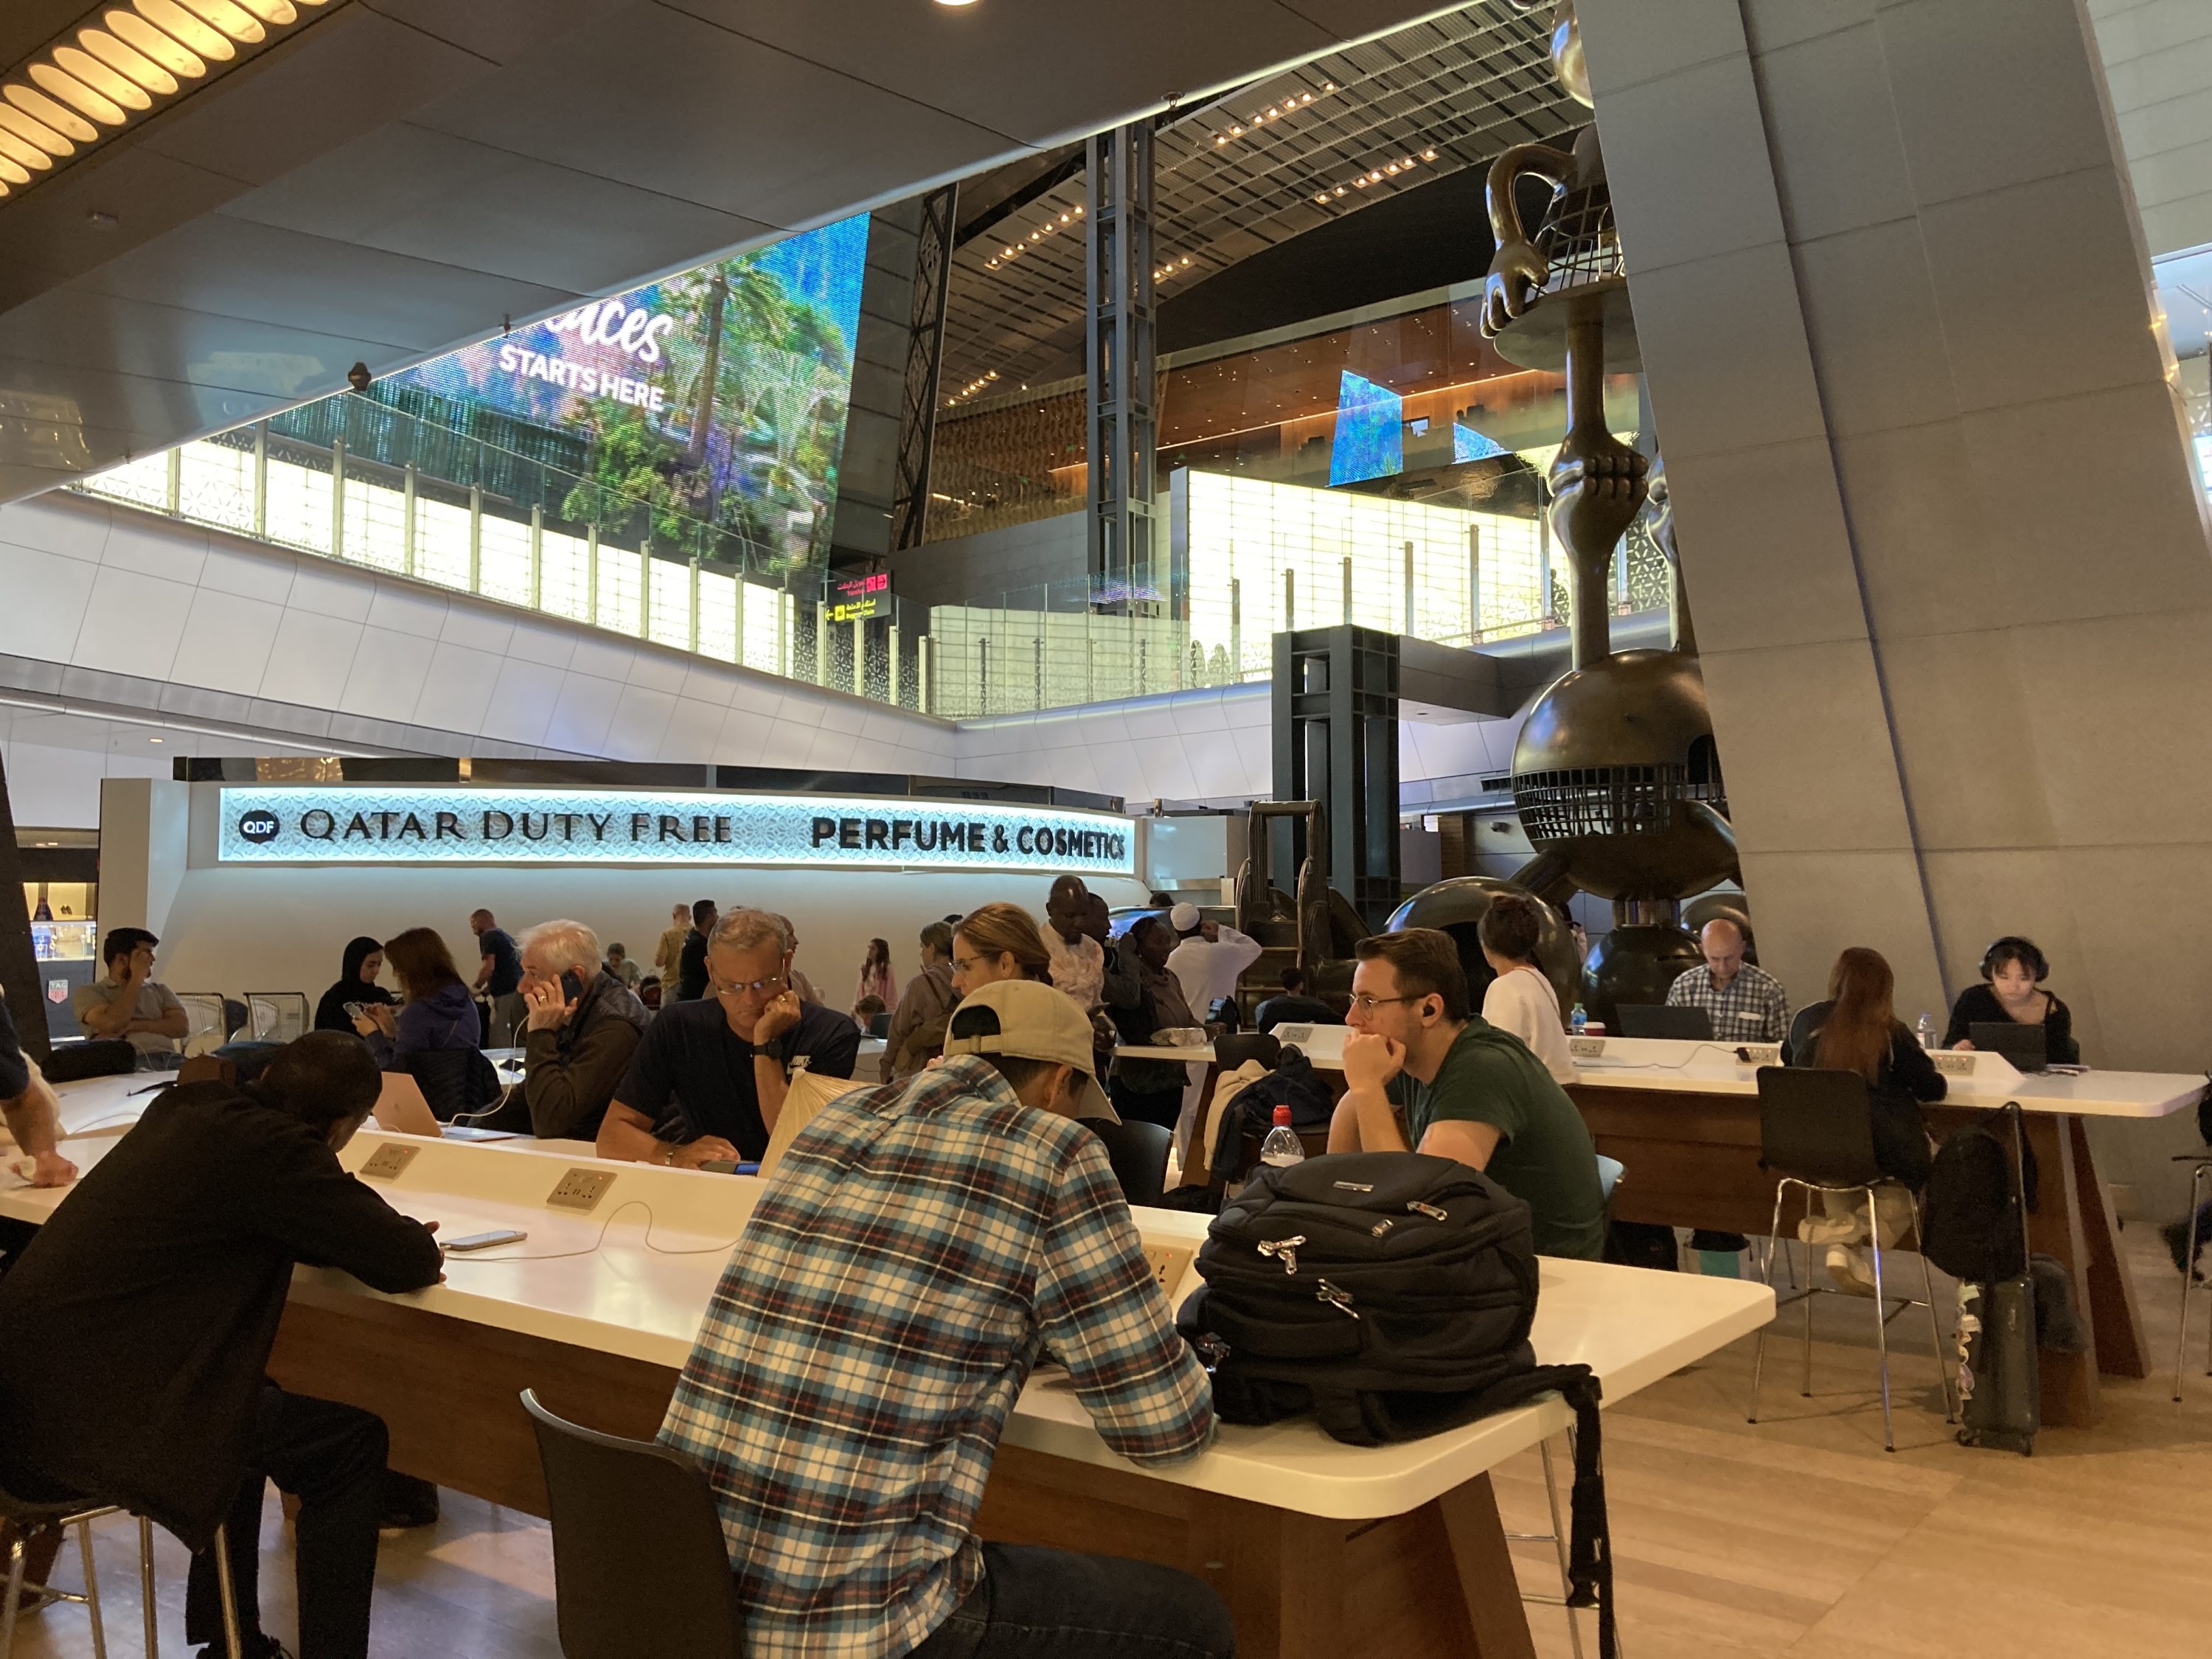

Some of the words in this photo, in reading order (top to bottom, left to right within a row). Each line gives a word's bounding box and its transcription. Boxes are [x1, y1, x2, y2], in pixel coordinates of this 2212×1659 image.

[500, 344, 598, 393] STARTS
[600, 373, 665, 412] HERE
[243, 821, 274, 834] QDF
[300, 809, 467, 844] QATAR
[483, 810, 612, 841] DUTY
[631, 813, 732, 843] FREE
[812, 817, 986, 853] PERFUME
[992, 824, 1009, 854] &
[1017, 825, 1125, 861] COSMETICS
